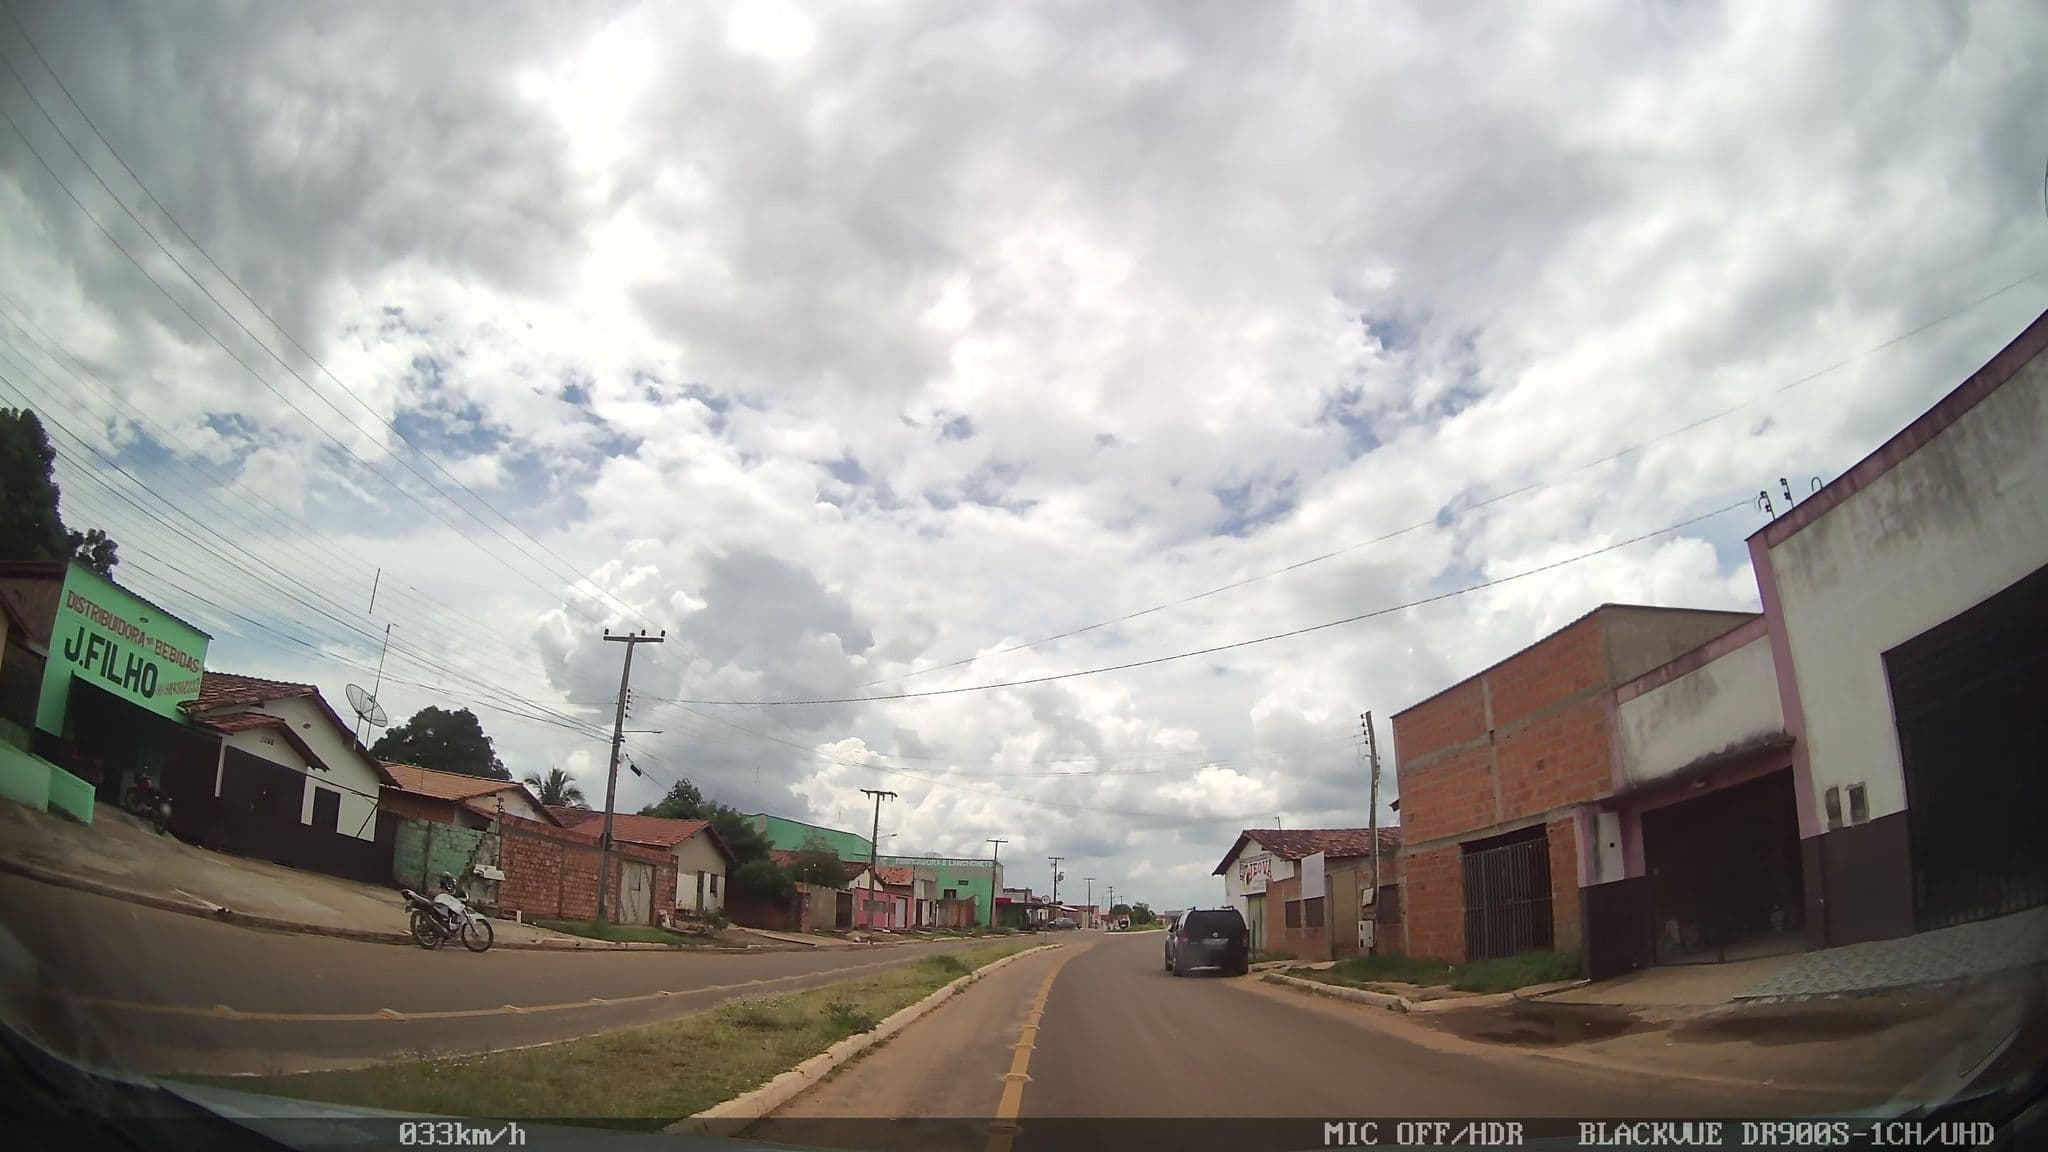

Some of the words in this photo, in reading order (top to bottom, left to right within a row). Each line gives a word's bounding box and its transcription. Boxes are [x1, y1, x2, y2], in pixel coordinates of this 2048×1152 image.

[64, 626, 158, 699] J.FILHO
[66, 590, 146, 648] DISTRIBUIDORA
[154, 639, 200, 673] BEBIDAS
